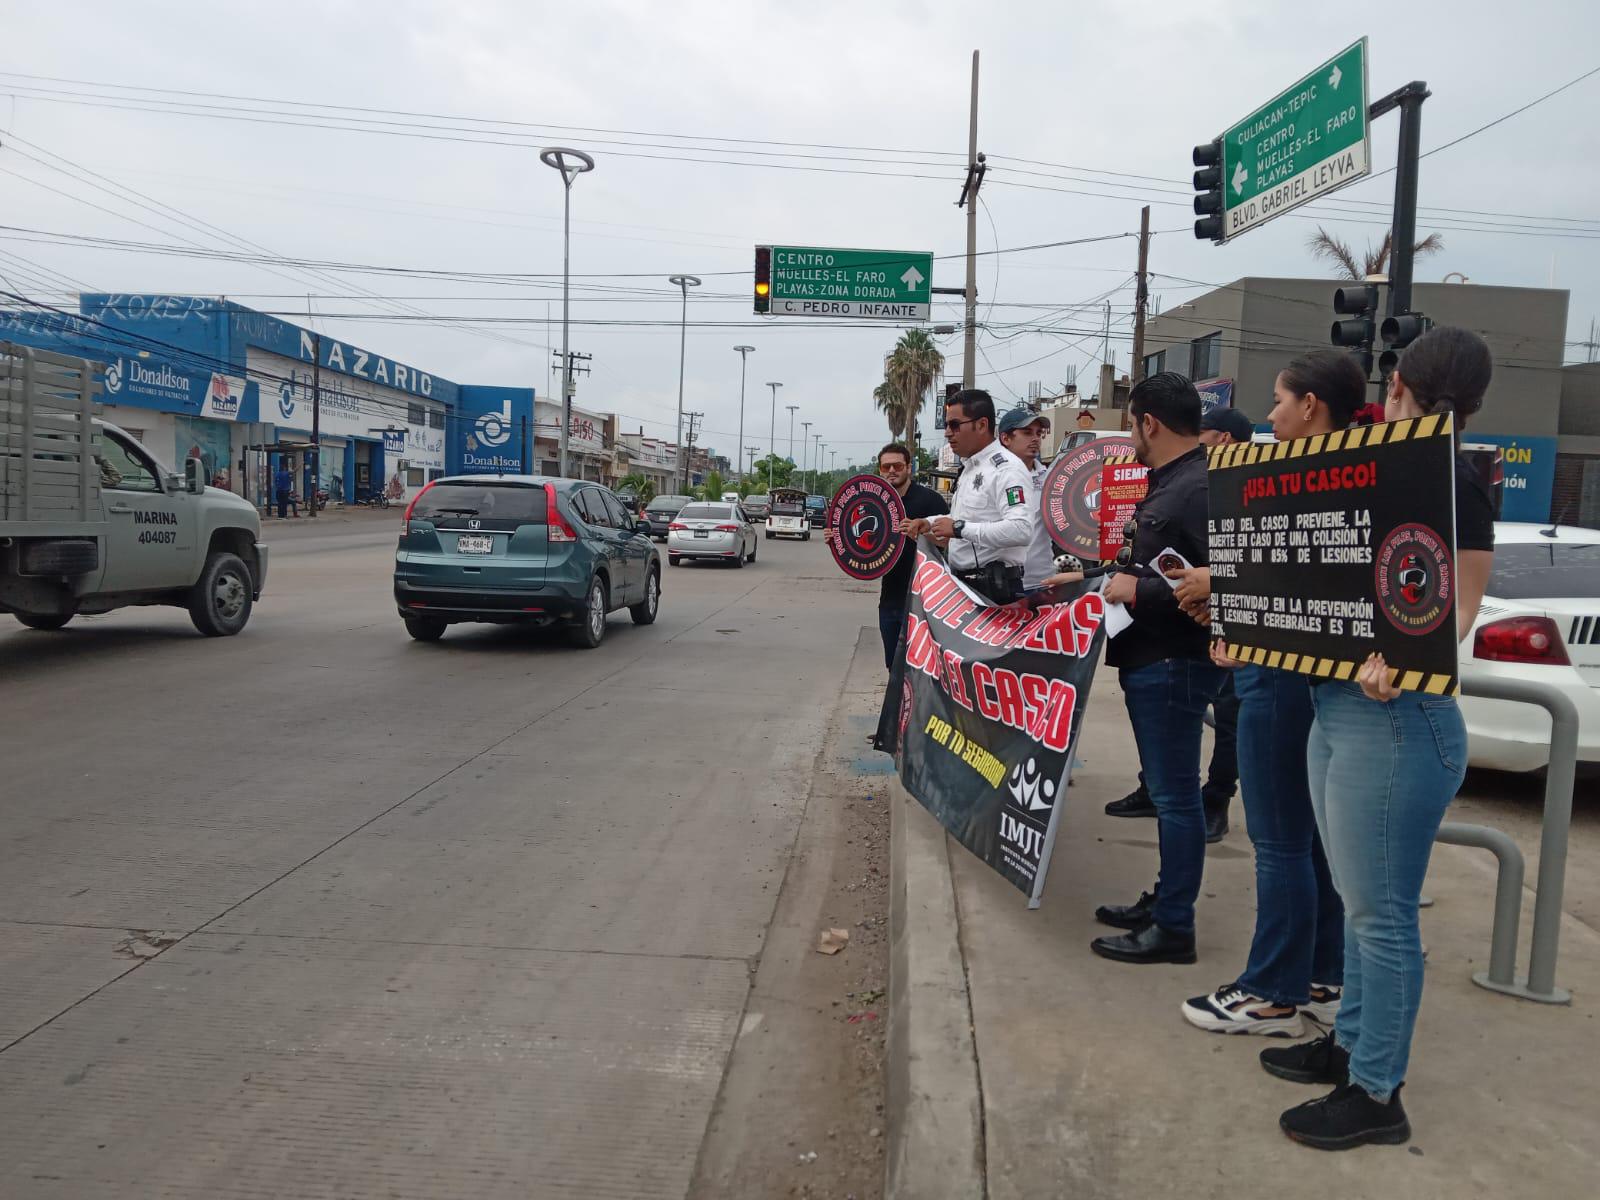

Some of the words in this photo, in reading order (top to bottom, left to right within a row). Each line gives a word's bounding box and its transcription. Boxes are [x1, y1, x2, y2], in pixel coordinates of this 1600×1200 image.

[1238, 85, 1317, 145] CULIACAN-TEPIC
[1257, 123, 1295, 156] CENTRO
[1257, 127, 1321, 173] MUELLES-EL
[1327, 106, 1356, 133] FARO
[1257, 159, 1294, 190] PLAYAS
[1233, 207, 1259, 228] BLVD.
[1262, 179, 1308, 213] GABRIEL
[1314, 153, 1355, 188] LEYVA
[777, 253, 834, 266] CENTRO
[777, 269, 850, 282] MUELLES-EL
[857, 272, 886, 283] FARO
[777, 283, 849, 297] PLAYAS-ZONA
[855, 286, 896, 298] DORADA
[785, 301, 796, 312] C.
[804, 302, 850, 314] PEDRO
[860, 305, 917, 316] INFANTE
[301, 330, 432, 396] NAZARIO
[129, 360, 190, 390] Donaldson
[464, 454, 521, 467] Donaldson
[1052, 475, 1069, 496] LAS
[1114, 467, 1149, 481] SIEMP
[1244, 477, 1276, 507] ¡USA
[1280, 473, 1301, 496] TU
[1306, 461, 1376, 492] CASCO!
[134, 512, 178, 525] MARINA
[1209, 520, 1217, 533] EL
[1222, 518, 1235, 532] USO
[1241, 518, 1255, 532] DEL
[1261, 515, 1289, 531] CASCO
[1297, 511, 1350, 529] PREVIENE,
[1355, 510, 1371, 526] LA
[139, 531, 176, 544] 404087
[1209, 534, 1235, 548] MUERTE
[1238, 534, 1248, 547] EN
[1251, 532, 1272, 547] CASO
[1275, 532, 1286, 546] DE
[1290, 531, 1309, 546] UNA
[1313, 527, 1358, 546] COLISIÓN
[1363, 529, 1371, 545] Y
[1209, 549, 1244, 563] DISMINUYE
[1252, 549, 1262, 563] UN
[1272, 549, 1288, 563] 85%
[1298, 549, 1310, 563] DE
[1321, 547, 1372, 564] LESIONES
[1210, 564, 1238, 578] GRAVES.
[1211, 593, 1219, 606] SU
[1222, 594, 1269, 611] EFECTIVIDAD
[1274, 597, 1285, 612] EN
[1290, 599, 1302, 614] LA
[1308, 598, 1374, 619] PREVENCIÓN
[1211, 608, 1220, 621] DE
[1225, 609, 1258, 625] LESIONES
[1264, 613, 1322, 632] CEREBRALES
[1329, 619, 1344, 635] ES
[1353, 621, 1375, 638] DEL
[972, 662, 1077, 753] CASO
[925, 715, 952, 746] POR
[949, 730, 965, 755] TU
